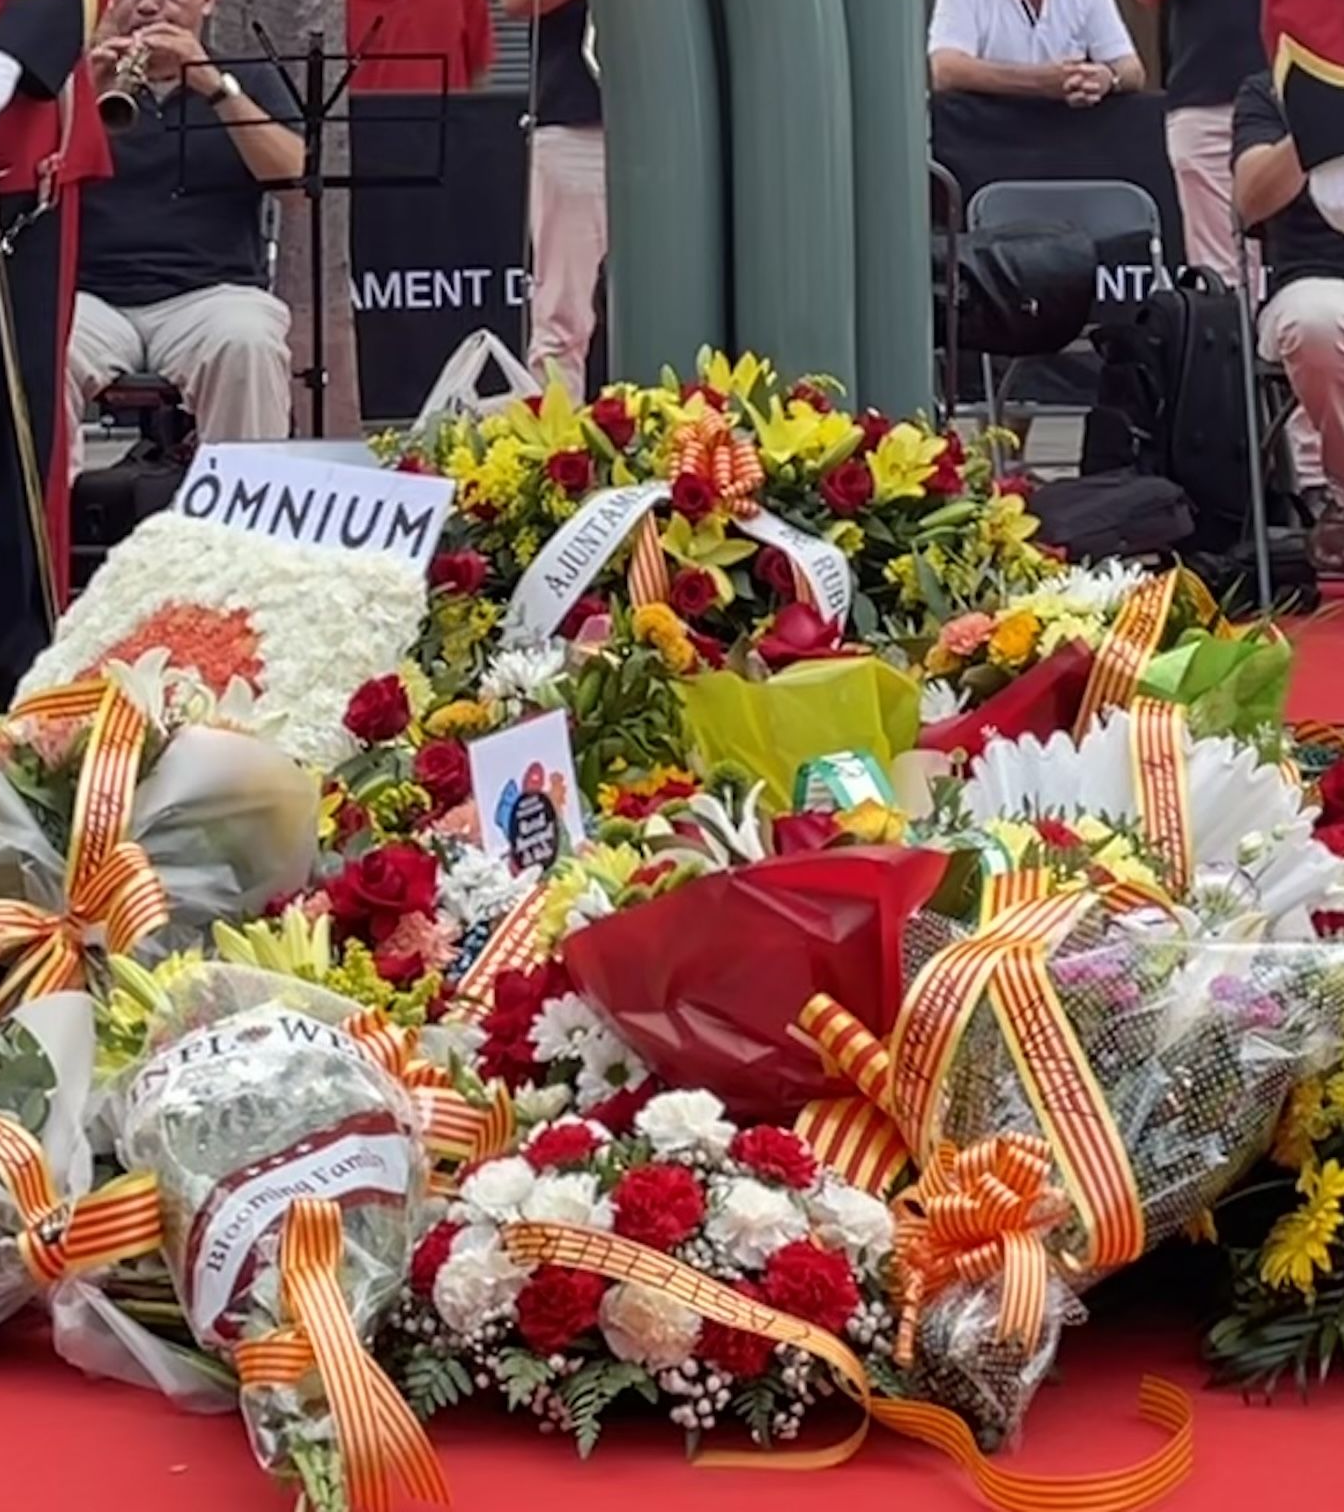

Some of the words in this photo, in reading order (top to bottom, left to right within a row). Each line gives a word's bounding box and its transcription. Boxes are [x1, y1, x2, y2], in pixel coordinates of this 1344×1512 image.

[183, 456, 435, 558] ÒMNIUM
[206, 1174, 315, 1274] Blooming
[311, 1145, 387, 1186] Family
